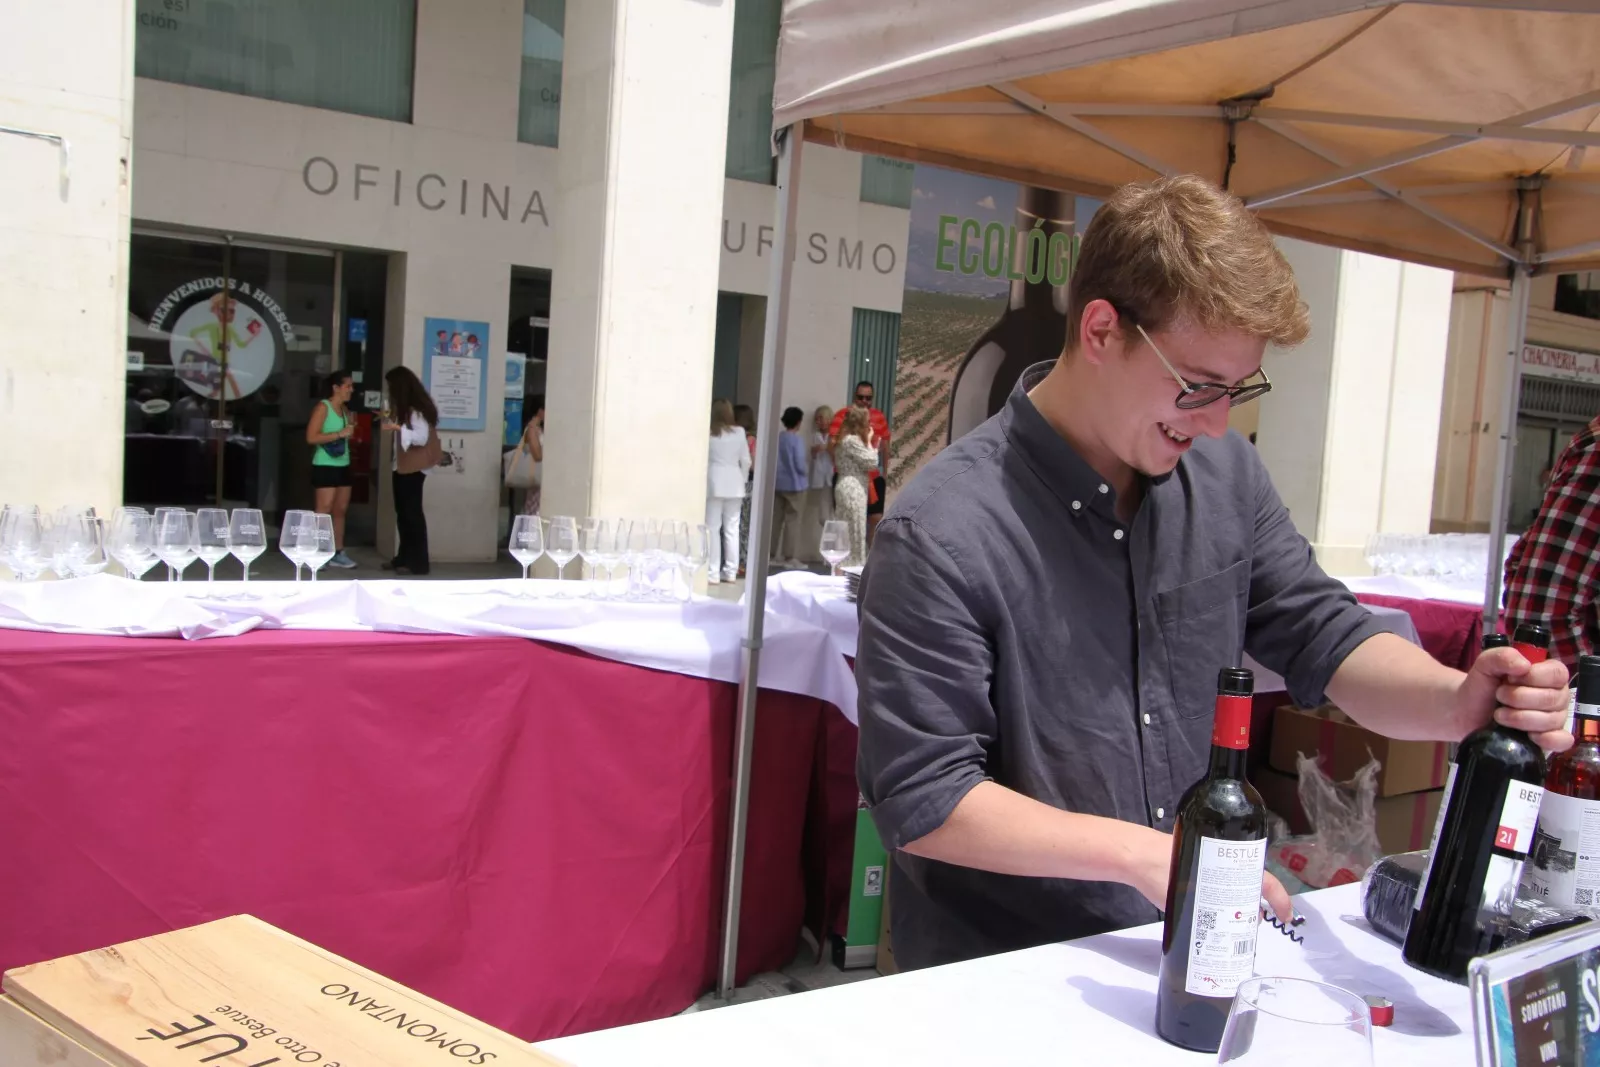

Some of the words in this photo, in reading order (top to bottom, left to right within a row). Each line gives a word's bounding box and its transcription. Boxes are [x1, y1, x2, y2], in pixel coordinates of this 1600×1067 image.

[138, 10, 177, 31] ción
[540, 87, 559, 104] Cu
[303, 157, 549, 227] OFICINA
[723, 219, 896, 274] URSMO
[935, 214, 1081, 287] ECOLÓGI
[147, 277, 236, 333] BIENVENIDOS
[239, 282, 251, 295] A
[252, 288, 294, 343] HUESCA
[1519, 789, 1541, 803] BEST
[1500, 830, 1513, 844] 21
[209, 1004, 277, 1039] Bestué
[320, 983, 497, 1065] SOMONTANO
[1521, 990, 1567, 1024] SOMONTANO
[275, 1036, 322, 1063] Otto
